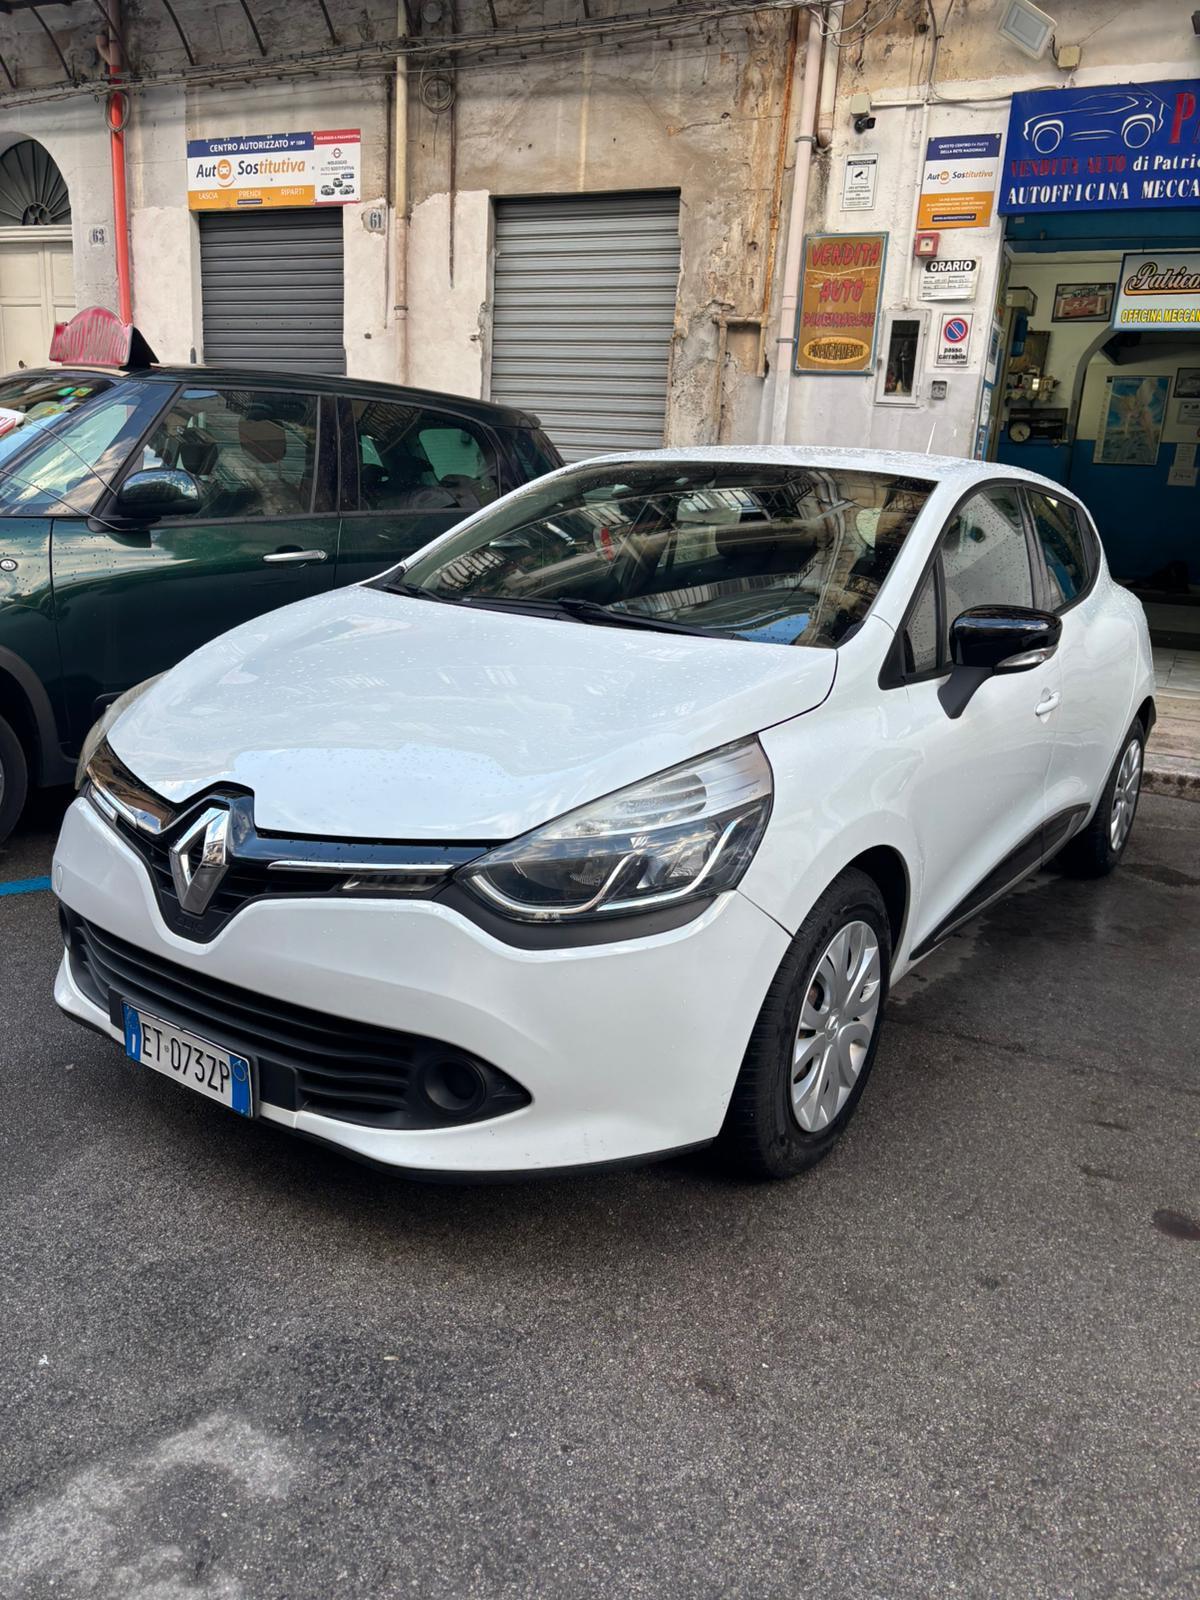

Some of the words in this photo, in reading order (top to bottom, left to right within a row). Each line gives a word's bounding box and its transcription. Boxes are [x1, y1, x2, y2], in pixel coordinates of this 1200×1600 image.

[1168, 93, 1200, 144] P
[209, 143, 238, 153] CENTRO
[239, 139, 288, 151] AUTORIZZATO
[237, 157, 305, 176] Sostitutiva
[1011, 157, 1079, 177] VENDITA
[1087, 154, 1127, 174] AUTO
[1133, 156, 1149, 171] di
[952, 171, 993, 179] Sostitutiva
[198, 191, 218, 200] LASCIA
[238, 190, 261, 198] PRENDI
[281, 188, 304, 196] RIPARTI
[1007, 182, 1129, 204] AUTOFFICINA
[1141, 178, 1200, 199] MECCA
[369, 212, 381, 229] 61
[92, 228, 104, 243] 63
[811, 242, 880, 267] VENDITA
[930, 260, 972, 272] ORARIO
[820, 278, 865, 303] AUTO
[1120, 309, 1162, 323] OFFICINA
